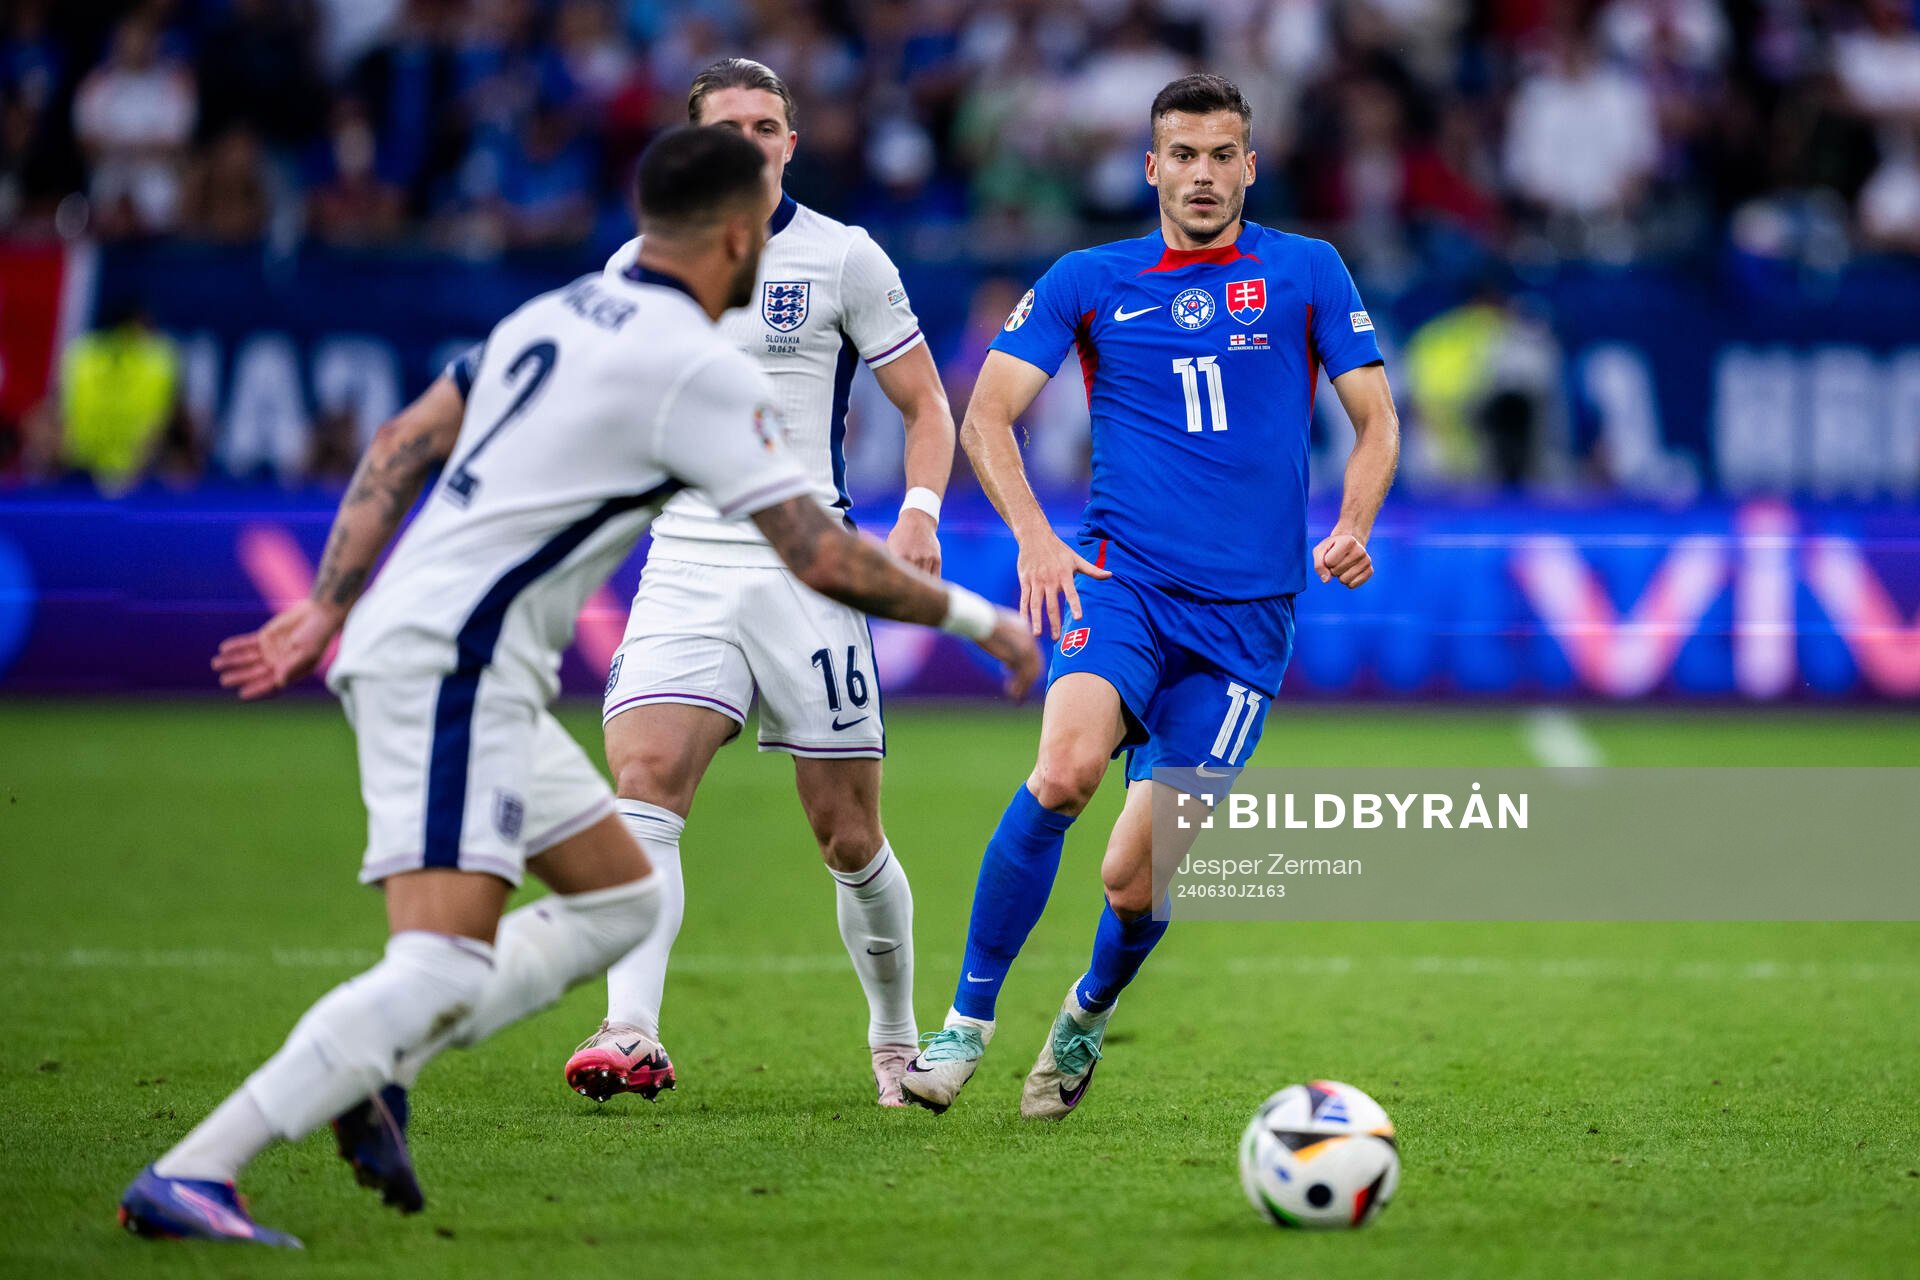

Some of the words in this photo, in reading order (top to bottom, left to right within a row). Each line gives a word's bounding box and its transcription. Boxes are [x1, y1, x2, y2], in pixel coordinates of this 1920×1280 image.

[765, 334, 800, 344] SLOVAKIA
[445, 337, 558, 507] 2
[1172, 355, 1228, 432] 11
[811, 645, 870, 712] 16
[1210, 681, 1263, 766] 11
